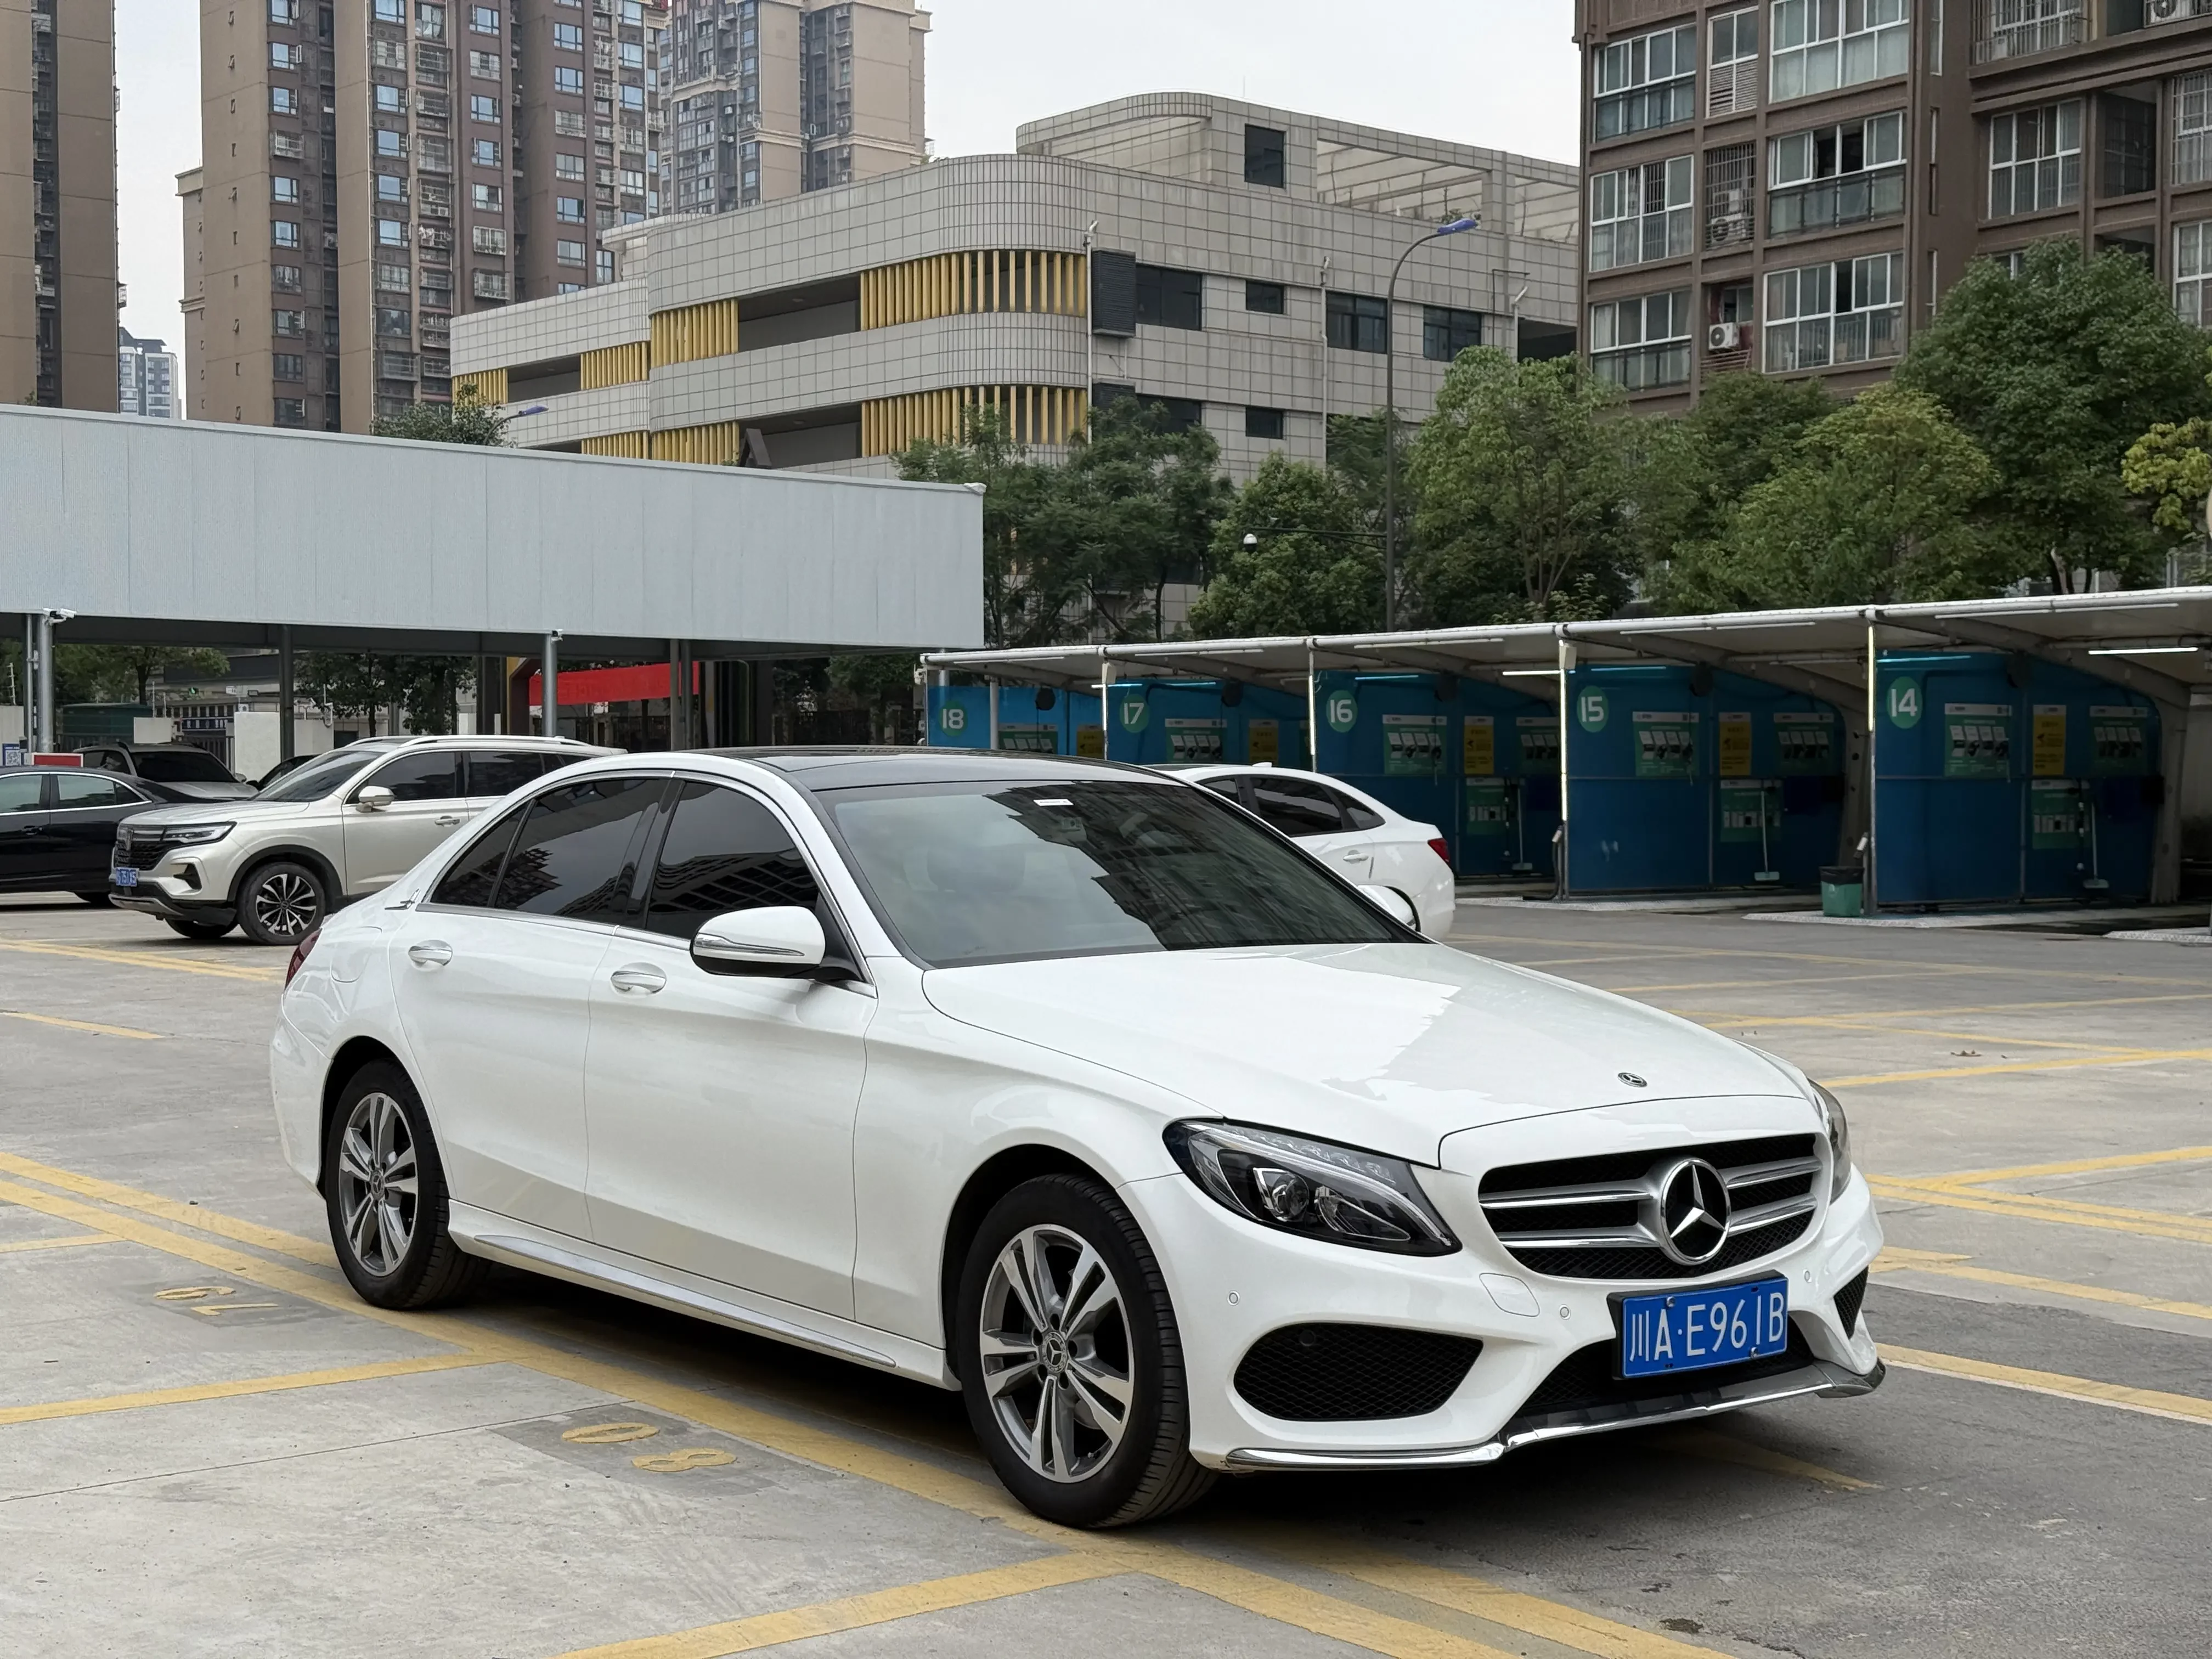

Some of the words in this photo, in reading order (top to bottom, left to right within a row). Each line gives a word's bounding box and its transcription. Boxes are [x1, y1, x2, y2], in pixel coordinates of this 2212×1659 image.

[1124, 702, 1144, 725] 17
[1330, 699, 1353, 723] 16
[1581, 696, 1604, 723] 15
[1891, 688, 1917, 717] 14
[942, 708, 964, 729] 18
